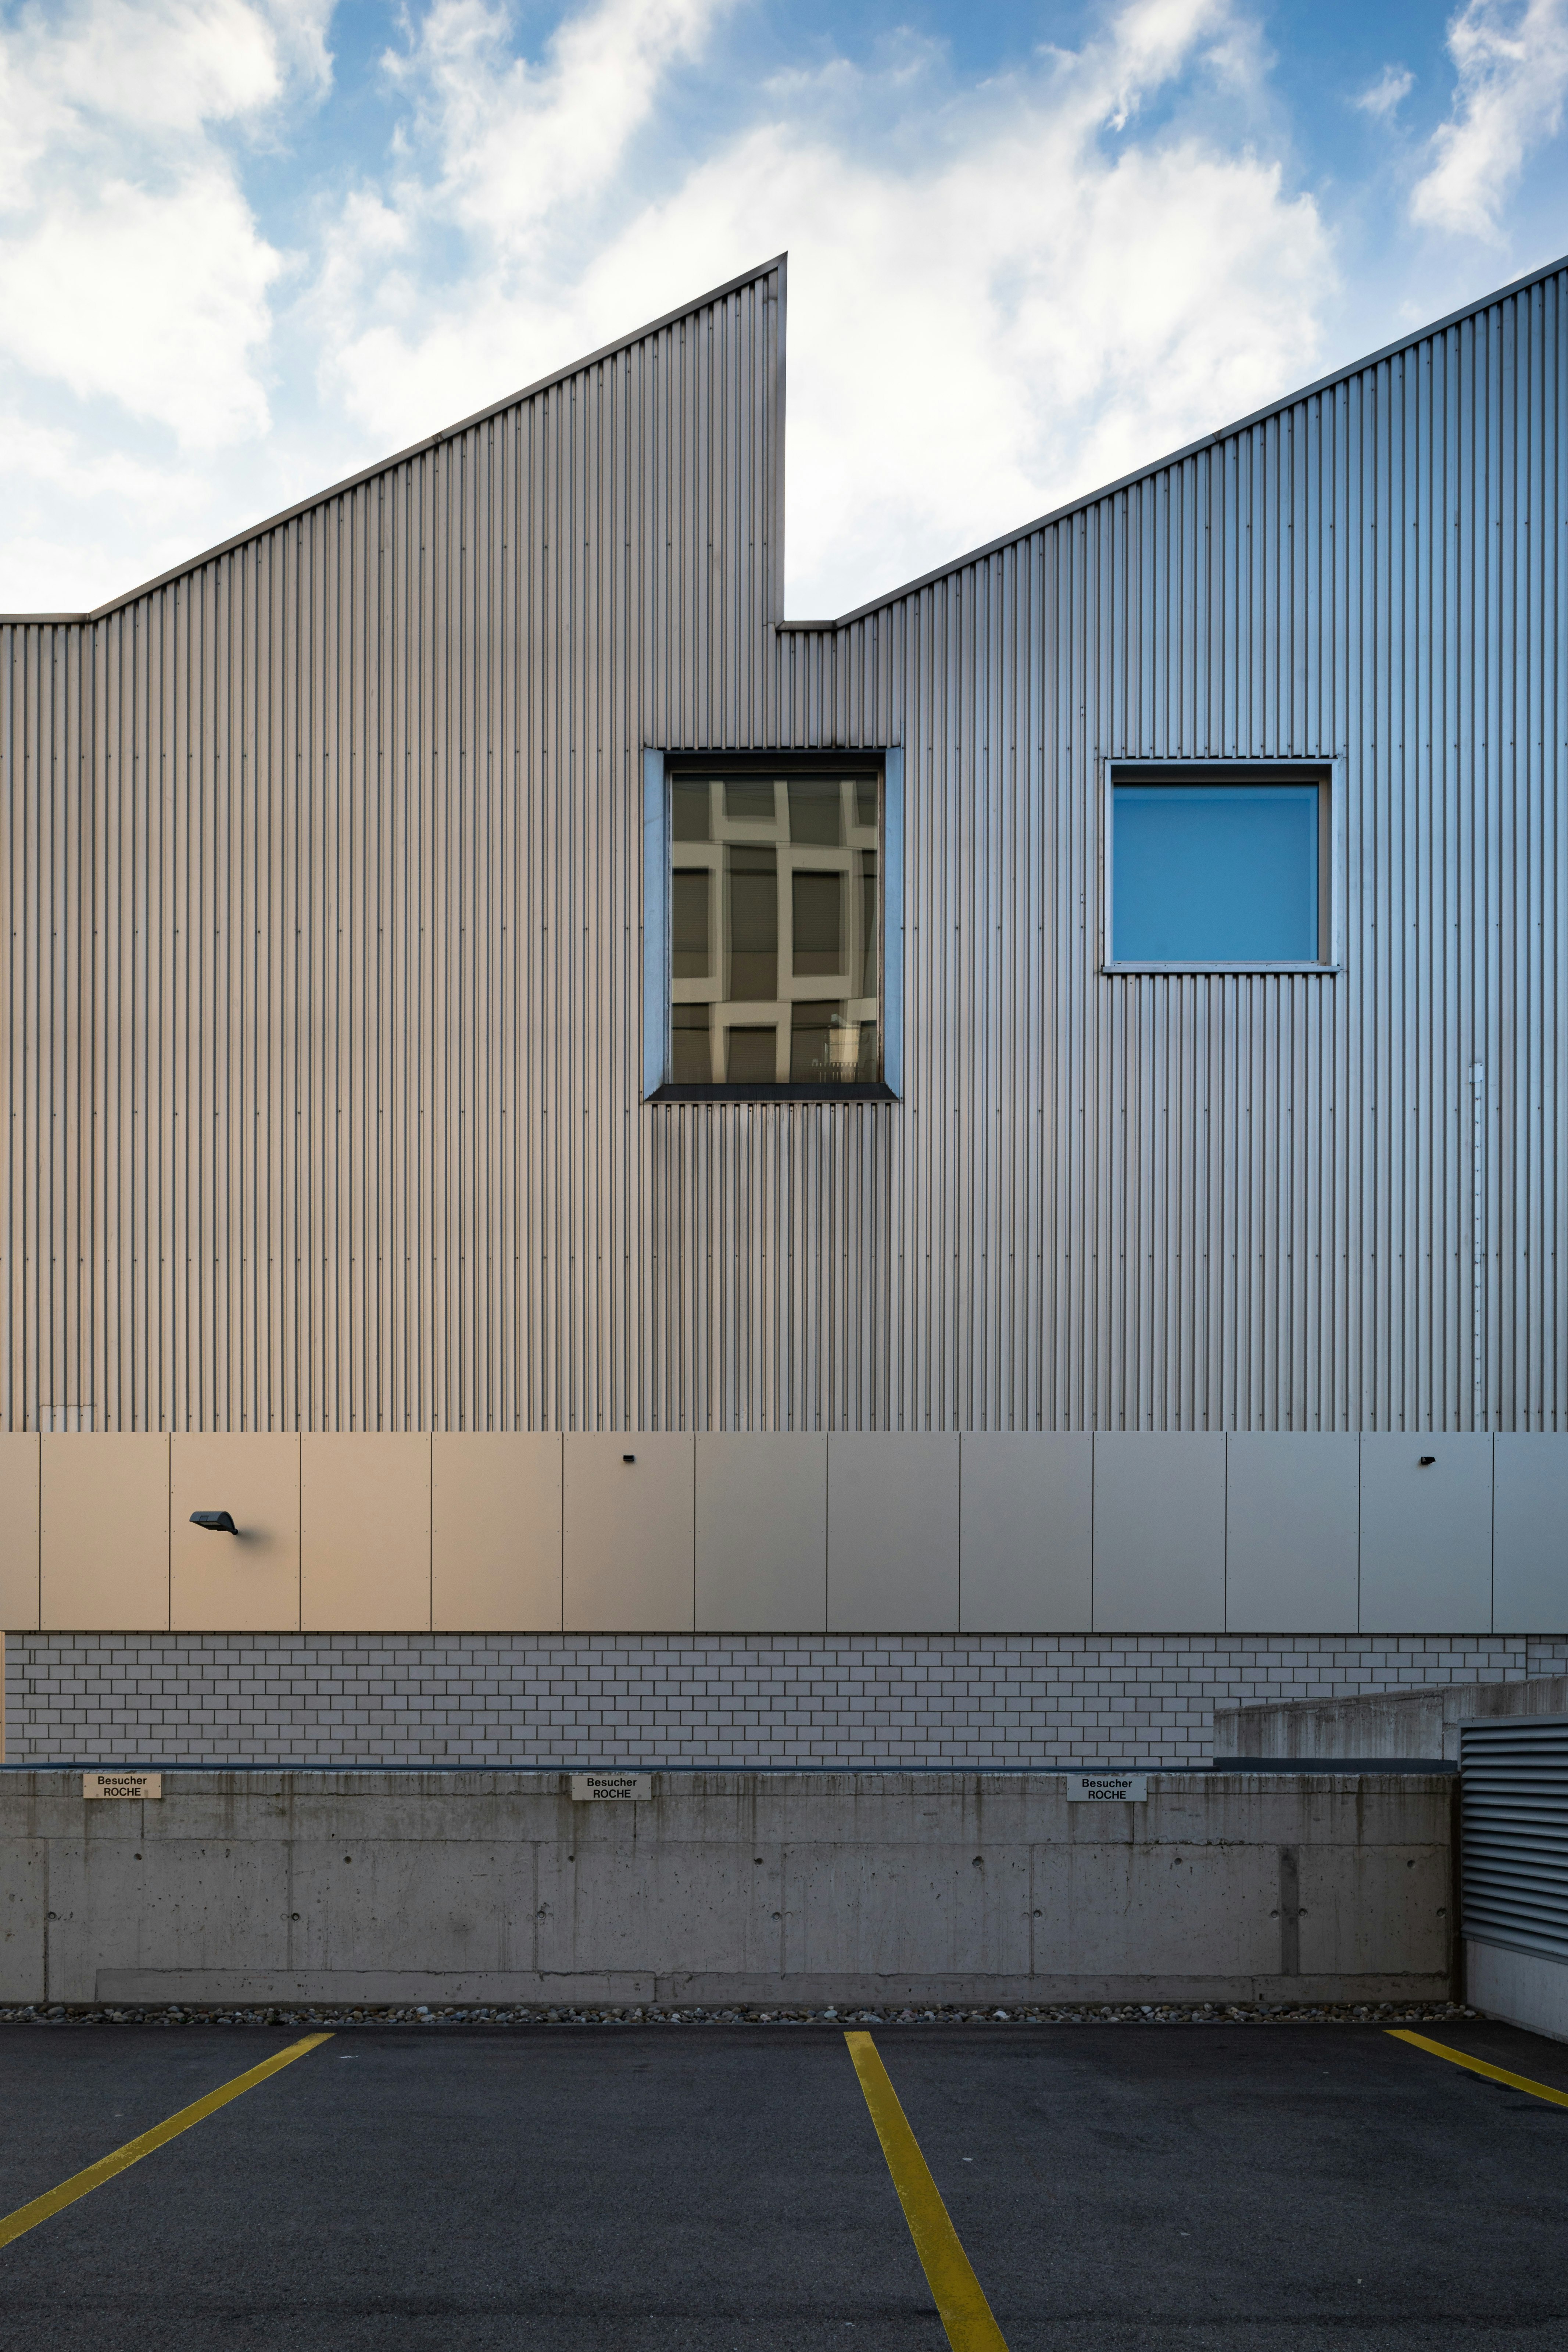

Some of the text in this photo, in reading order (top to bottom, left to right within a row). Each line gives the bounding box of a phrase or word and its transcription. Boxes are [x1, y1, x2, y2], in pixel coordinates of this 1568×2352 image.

[98, 1776, 147, 1785] Besucher
[587, 1778, 637, 1786] Besucher
[1082, 1779, 1132, 1787] Besucher
[104, 1787, 141, 1796] ROCHE
[593, 1789, 631, 1798] ROCHE
[1088, 1790, 1126, 1799] ROCHE
